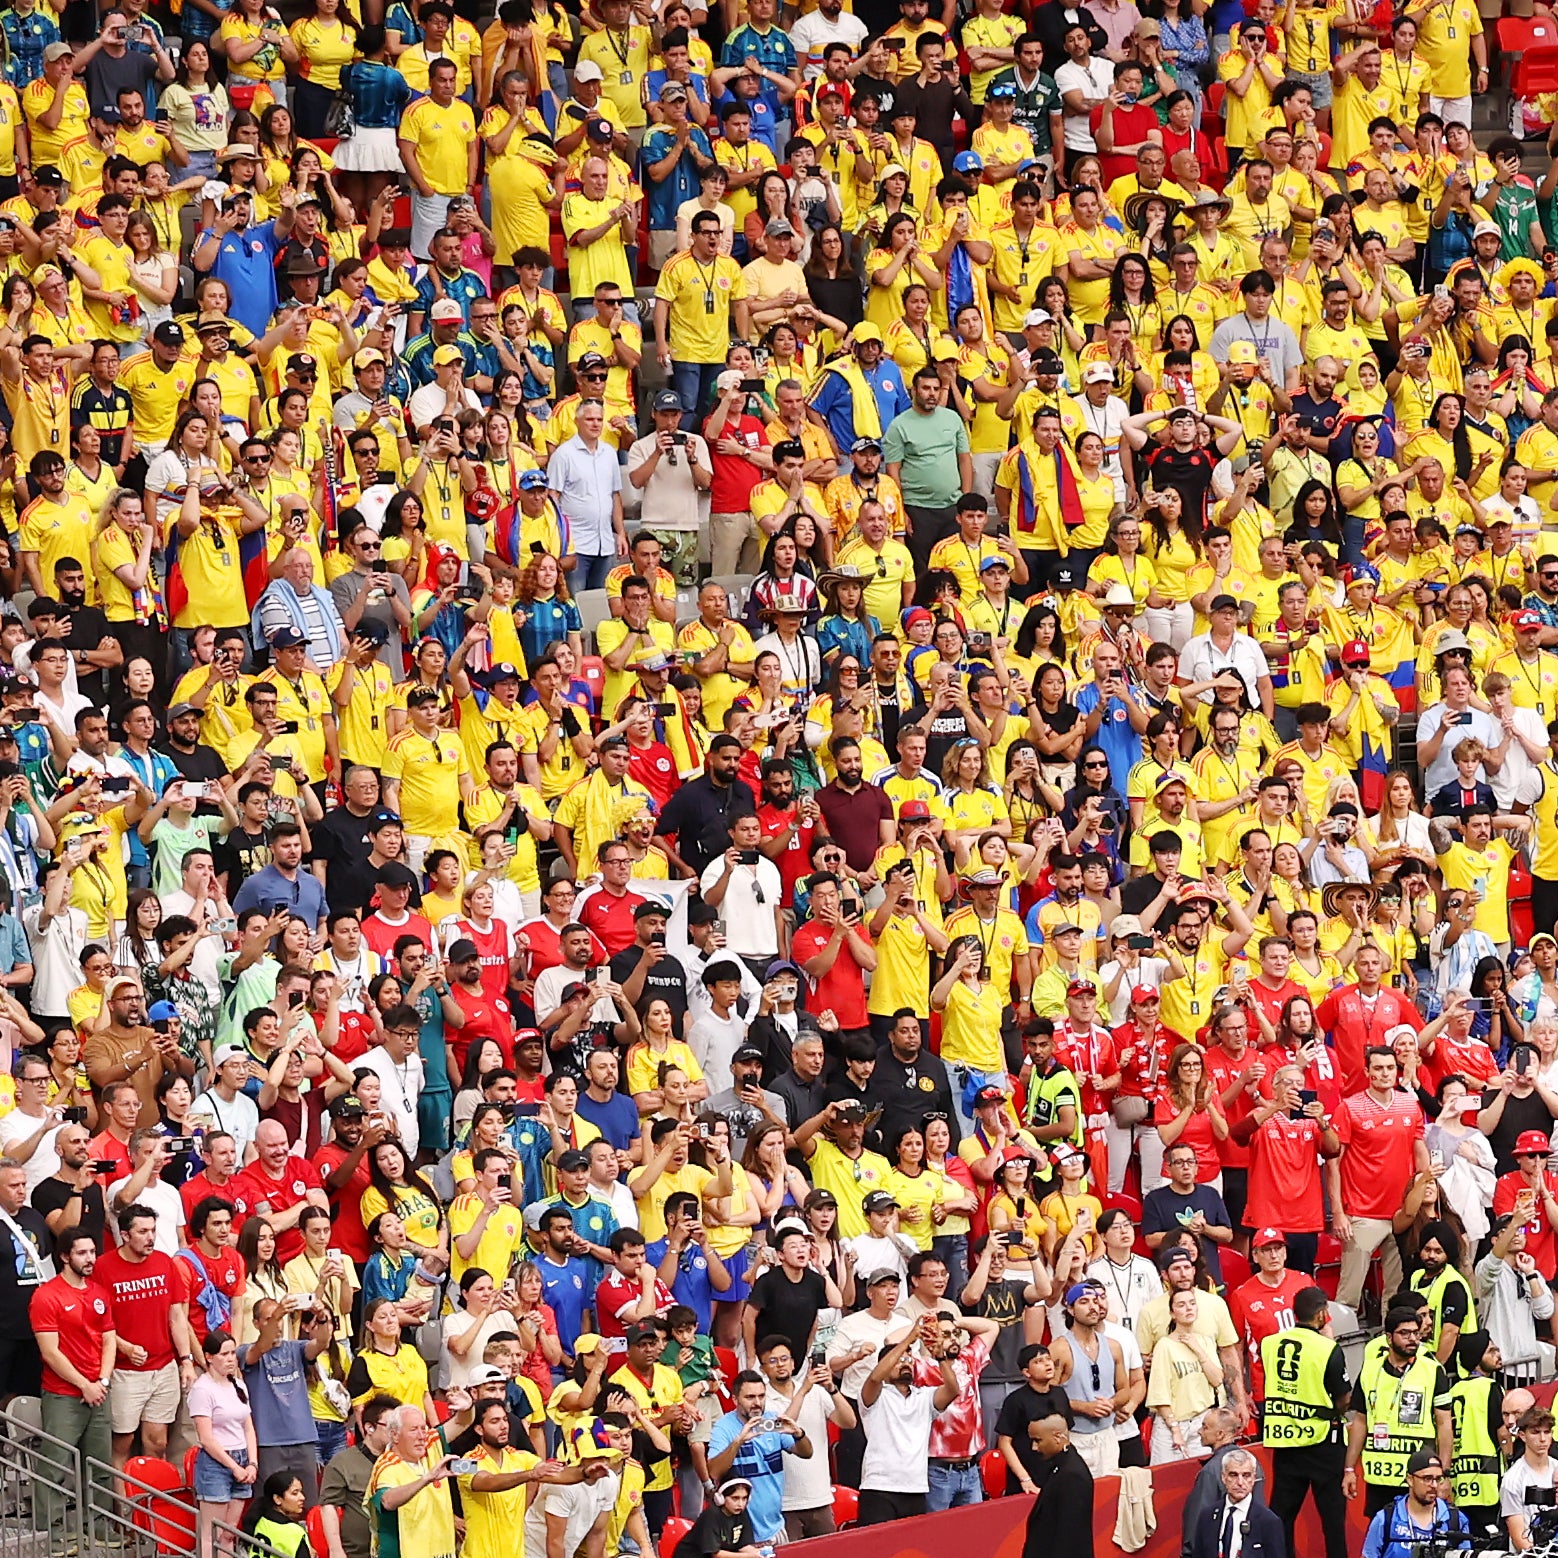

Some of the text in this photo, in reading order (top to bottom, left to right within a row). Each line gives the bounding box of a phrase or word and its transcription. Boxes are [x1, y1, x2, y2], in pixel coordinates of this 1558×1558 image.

[1509, 218, 1519, 236] 14
[1530, 1216, 1541, 1233] 5
[113, 1273, 167, 1295] TRINITY
[114, 1287, 169, 1303] ATHLETICS
[1275, 1307, 1296, 1332] 10
[1264, 1402, 1317, 1420] ECURITY
[1365, 1460, 1405, 1478] 1832
